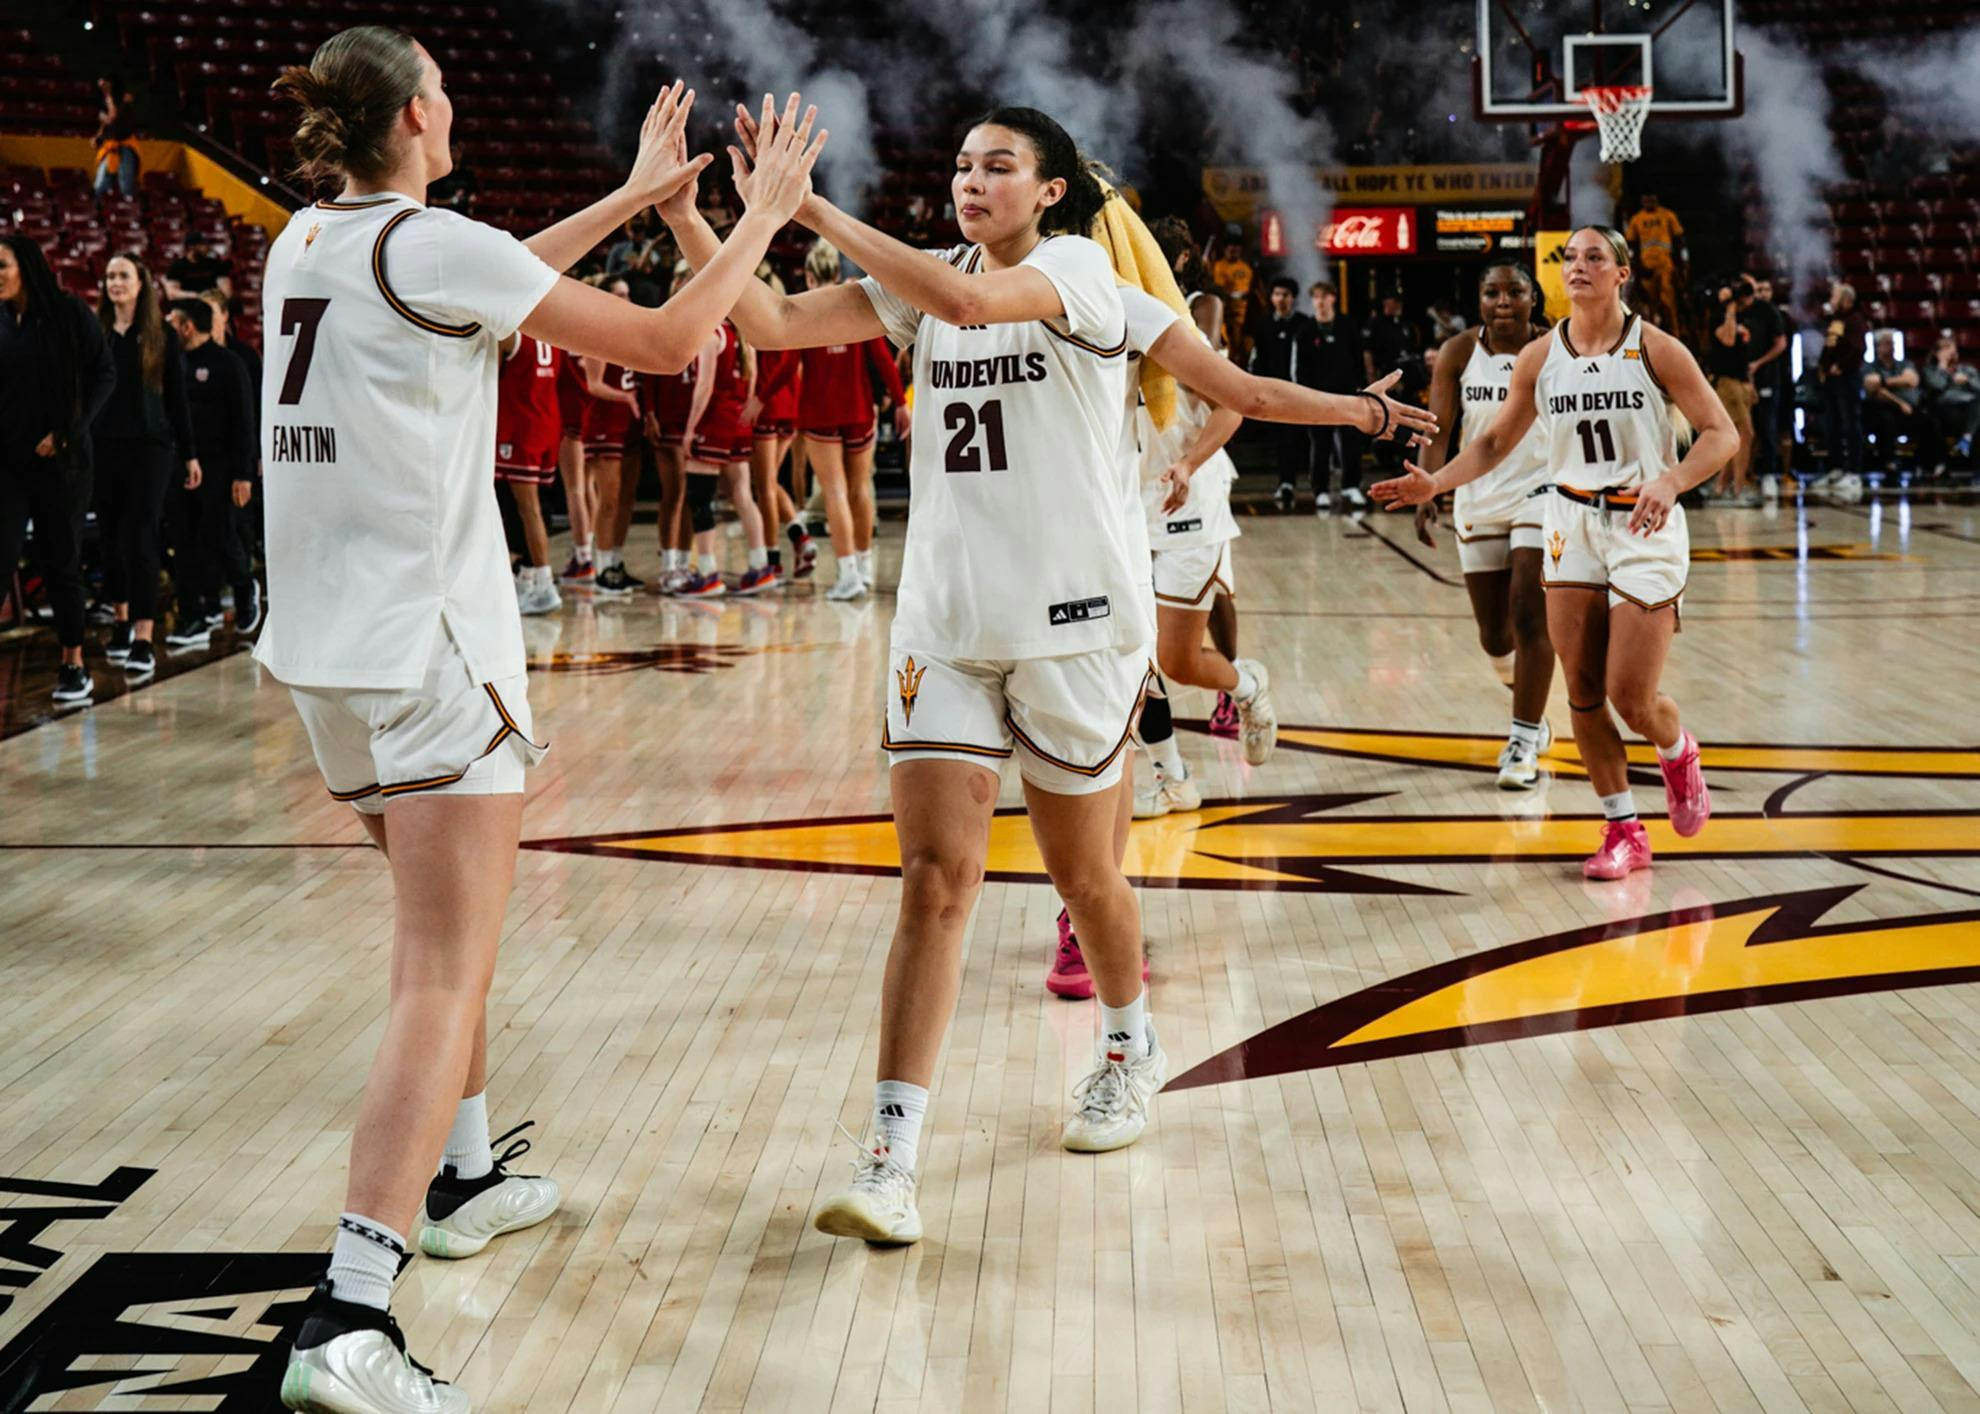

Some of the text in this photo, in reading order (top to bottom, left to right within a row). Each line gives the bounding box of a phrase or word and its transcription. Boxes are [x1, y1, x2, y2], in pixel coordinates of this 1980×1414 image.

[1355, 174, 1397, 191] HOPE
[1405, 173, 1425, 191] YE
[1432, 173, 1474, 190] WHO
[278, 298, 331, 405] 7
[1466, 386, 1493, 401] SUN
[1549, 391, 1644, 414] SUN DEVILS
[273, 425, 336, 463] FANTINI
[944, 399, 1008, 473] 21
[1576, 419, 1616, 463] 11
